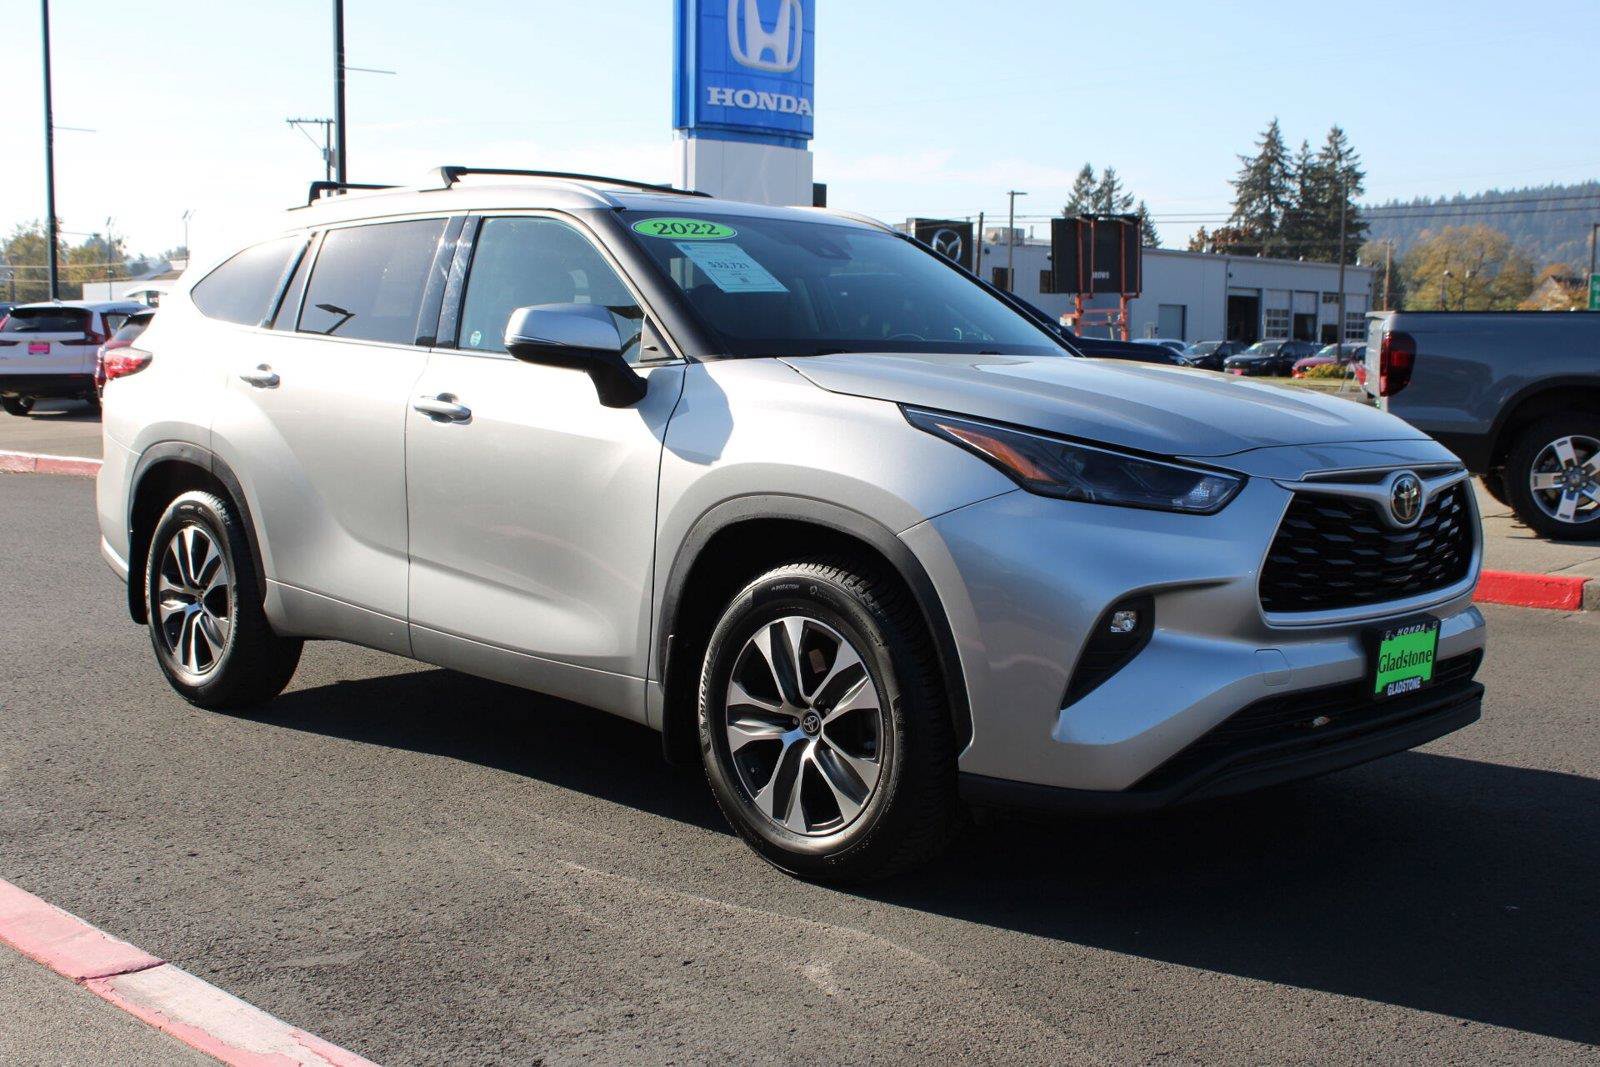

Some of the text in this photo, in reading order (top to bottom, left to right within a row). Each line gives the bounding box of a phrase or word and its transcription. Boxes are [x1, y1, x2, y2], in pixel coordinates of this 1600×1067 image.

[707, 86, 813, 117] HONDA
[652, 222, 721, 236] 2022
[1378, 649, 1433, 674] Gladstone
[1387, 676, 1422, 696] GLADSTONE
